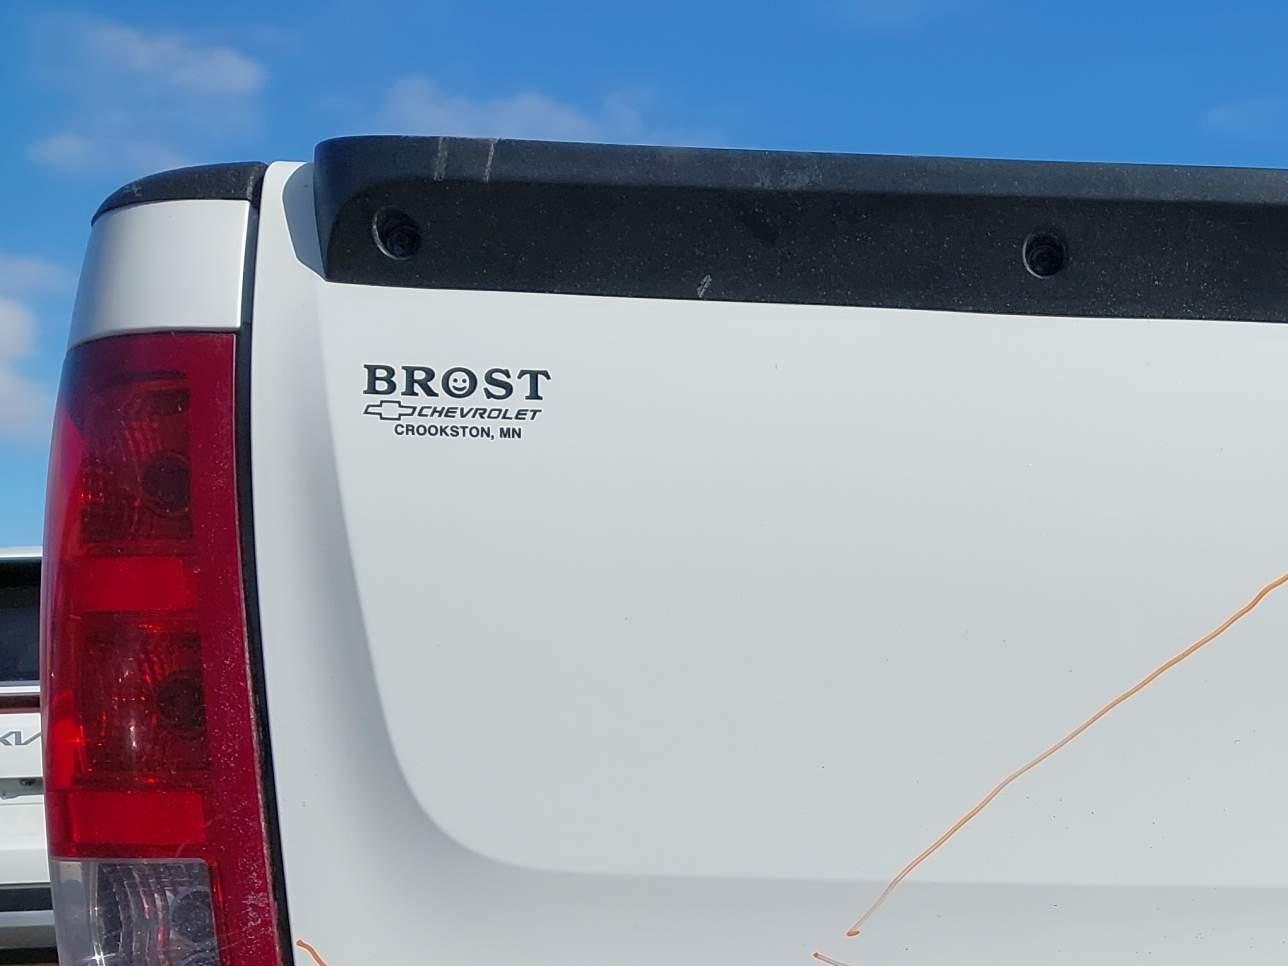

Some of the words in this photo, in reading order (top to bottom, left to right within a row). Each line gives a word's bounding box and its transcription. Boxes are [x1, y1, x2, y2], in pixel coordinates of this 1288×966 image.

[363, 364, 551, 400] BROST
[417, 405, 542, 421] CHEVROLET
[394, 424, 495, 440] CROOKSTON,
[499, 427, 522, 439] MN
